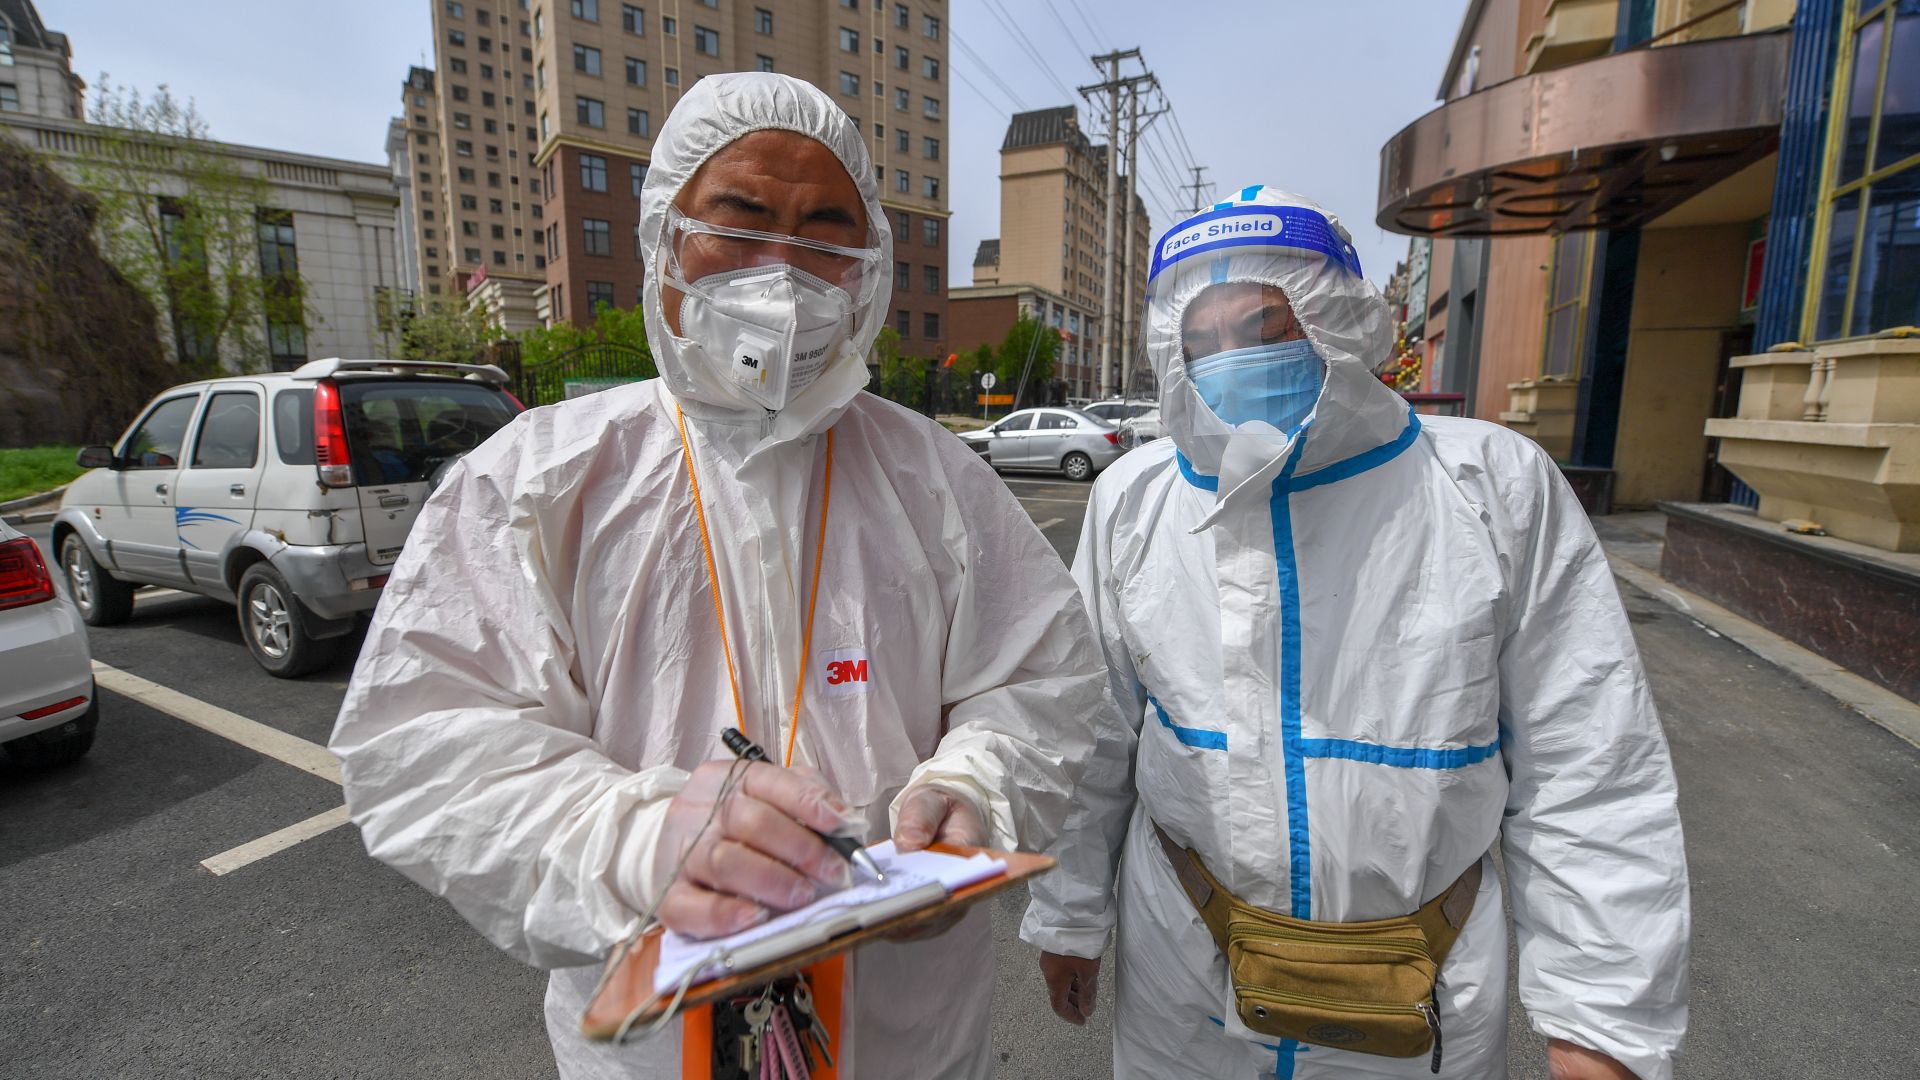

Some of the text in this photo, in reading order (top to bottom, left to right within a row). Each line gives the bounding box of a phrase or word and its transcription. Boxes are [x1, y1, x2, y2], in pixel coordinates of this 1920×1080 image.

[1166, 232, 1200, 255] Face
[1208, 220, 1273, 237] Shield
[741, 355, 759, 369] 3M
[794, 351, 808, 362] 3M
[826, 659, 868, 685] 3M
